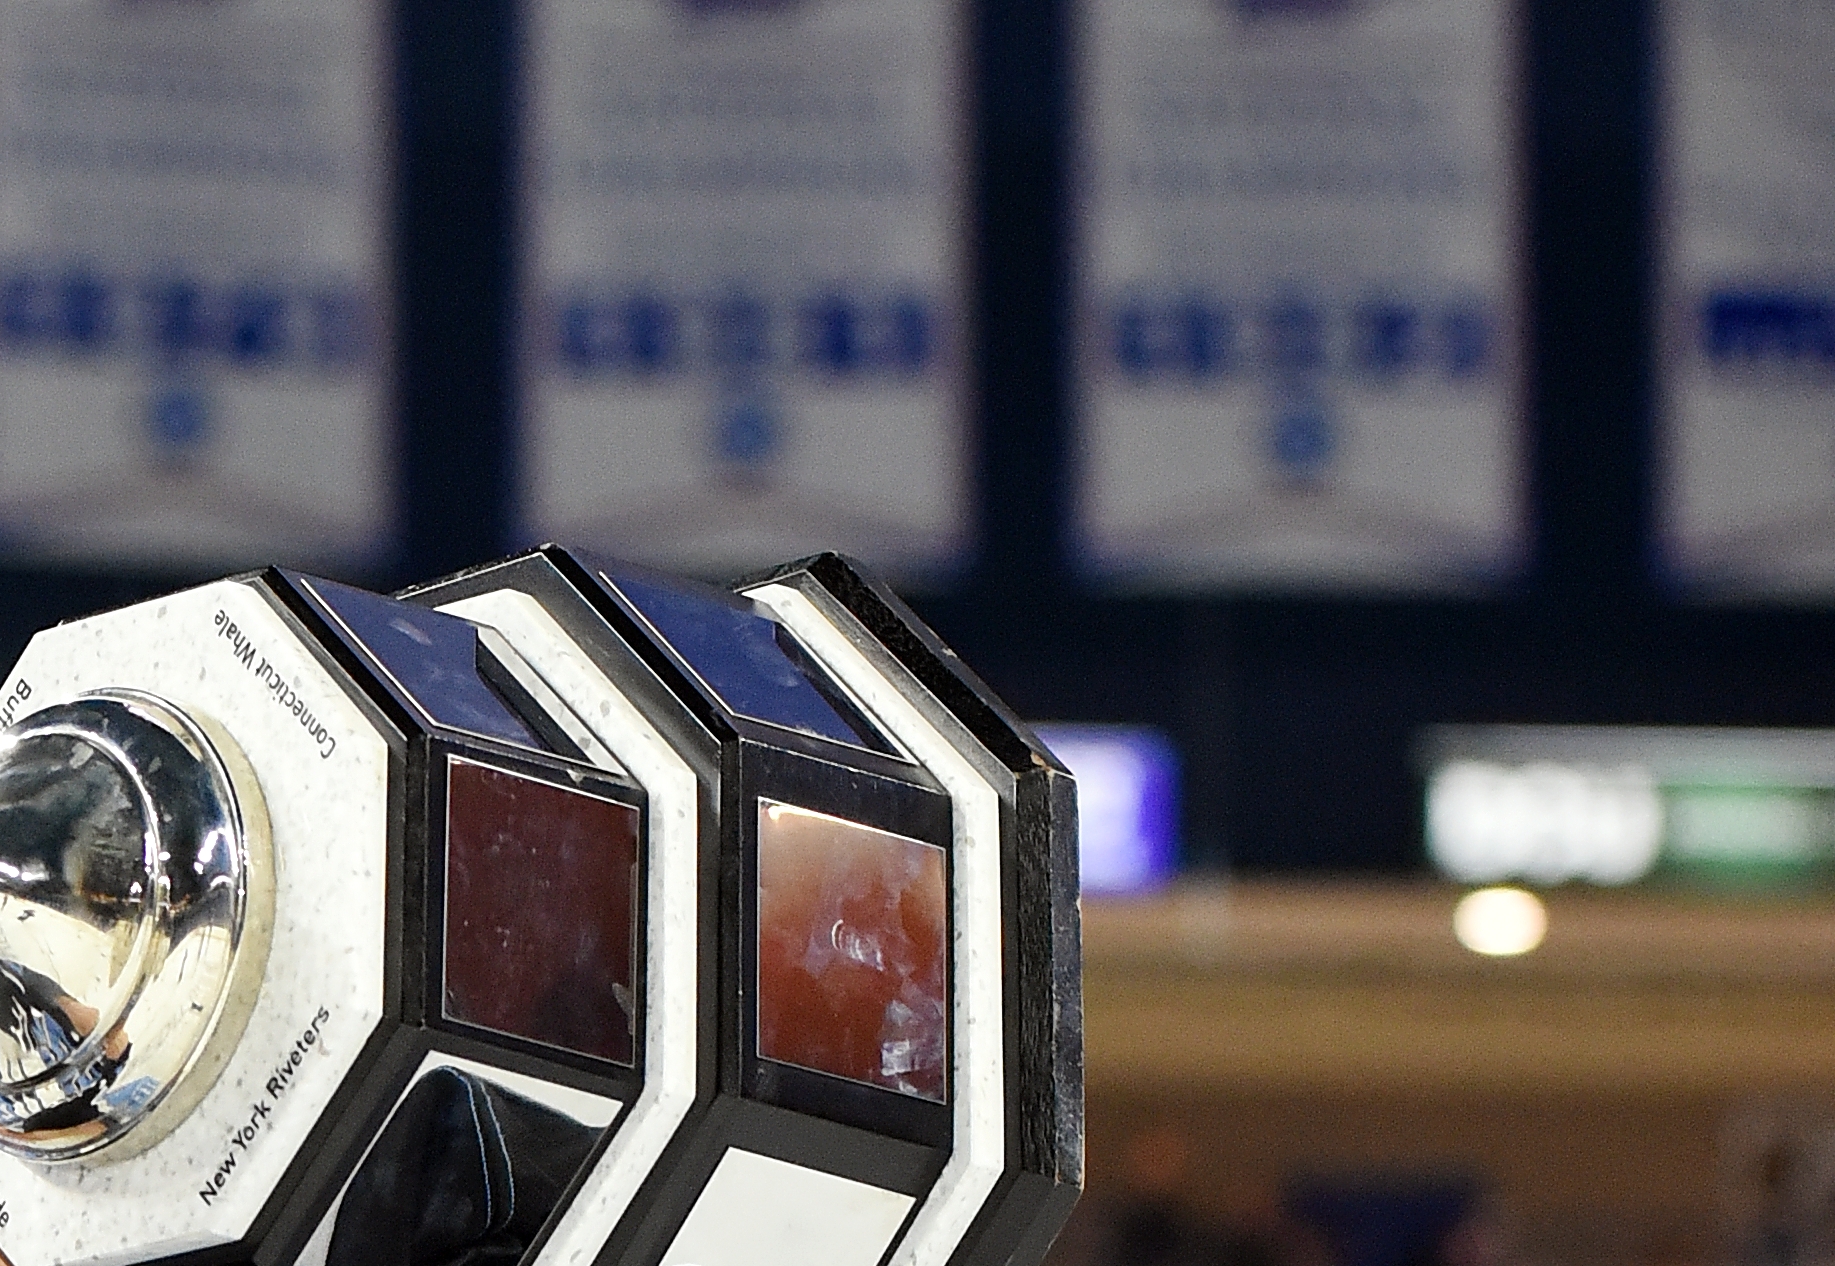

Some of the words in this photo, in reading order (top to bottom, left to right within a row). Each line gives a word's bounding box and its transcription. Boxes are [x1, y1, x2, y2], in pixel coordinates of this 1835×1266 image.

[214, 609, 257, 670] Whale
[255, 657, 336, 759] Connecticut
[199, 1152, 237, 1206] New
[232, 1099, 271, 1150] York
[265, 1005, 330, 1100] Riveters
